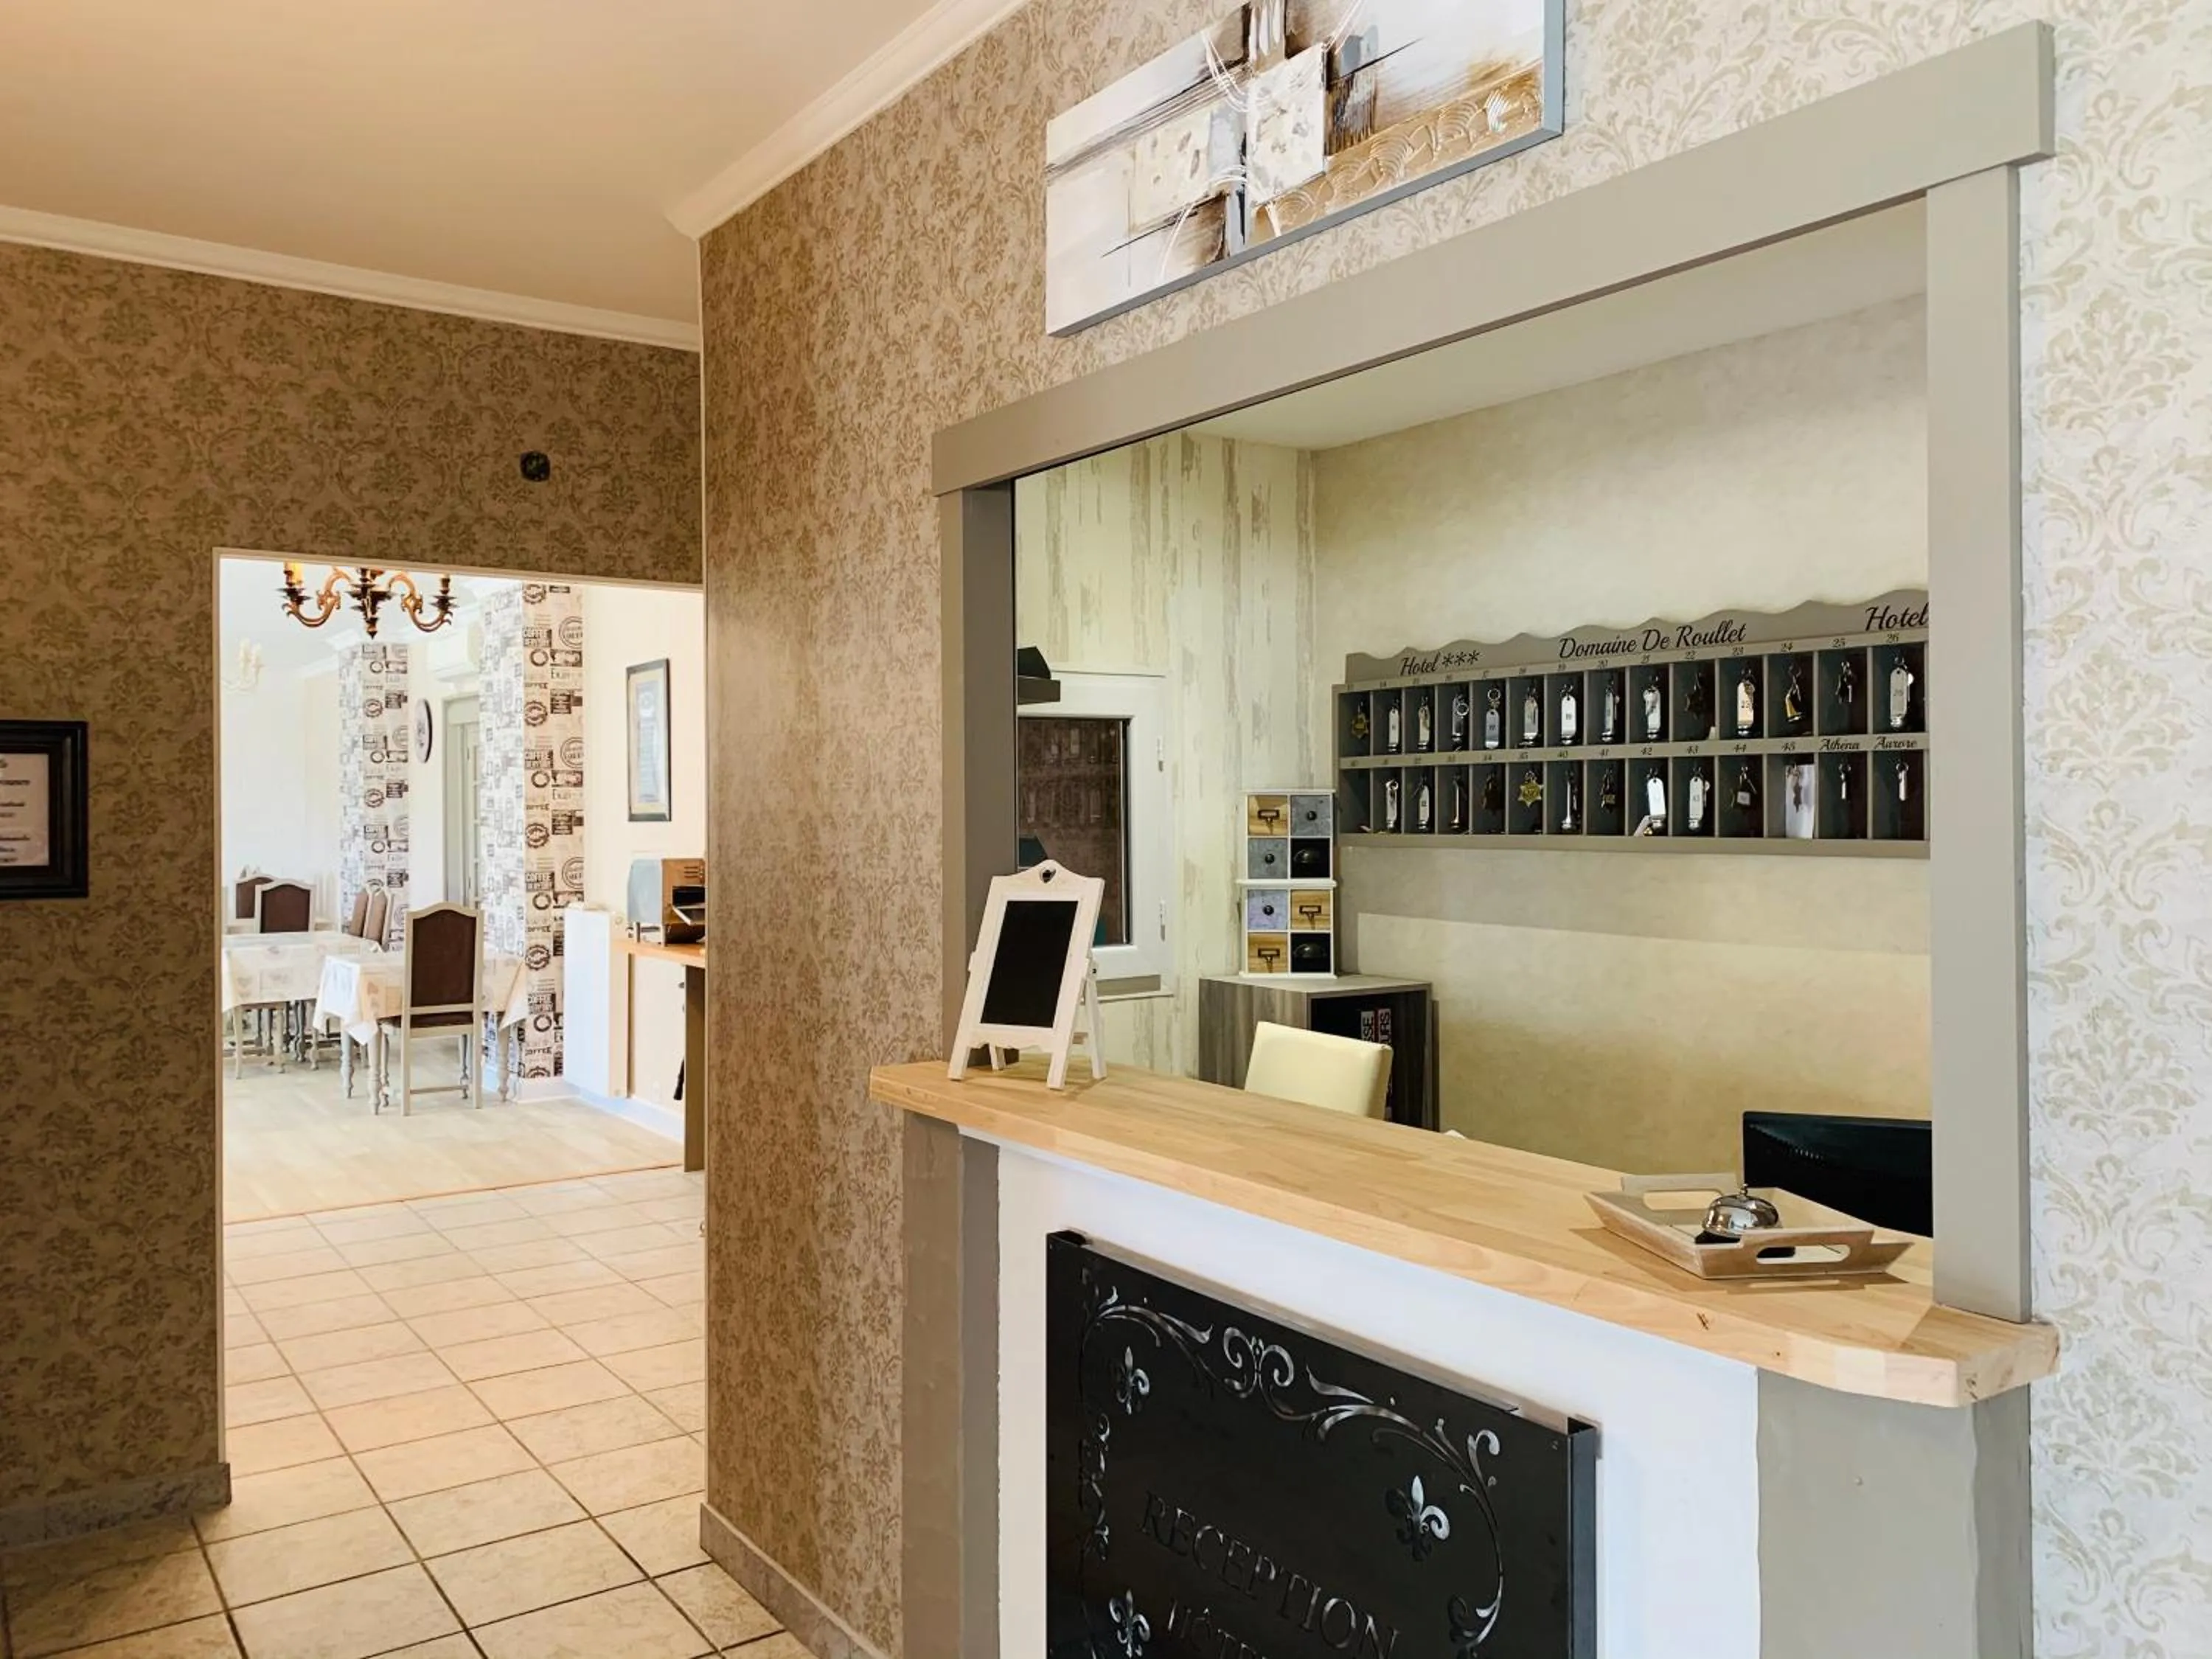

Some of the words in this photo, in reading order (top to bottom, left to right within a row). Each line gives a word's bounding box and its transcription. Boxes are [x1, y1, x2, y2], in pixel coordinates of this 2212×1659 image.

[1865, 601, 1929, 632] Hotel
[1559, 635, 1637, 658] Domaine
[1642, 628, 1671, 652] De
[1676, 619, 1747, 648] Roullet
[1886, 632, 1899, 643] 26
[1781, 641, 1793, 653] 24
[1832, 638, 1846, 649] 25
[1401, 652, 1440, 676] Hotel
[1641, 745, 1652, 756] 42
[1734, 742, 1747, 753] 44
[1781, 742, 1796, 752] 45
[1141, 1489, 1400, 1659] RECEPTION
